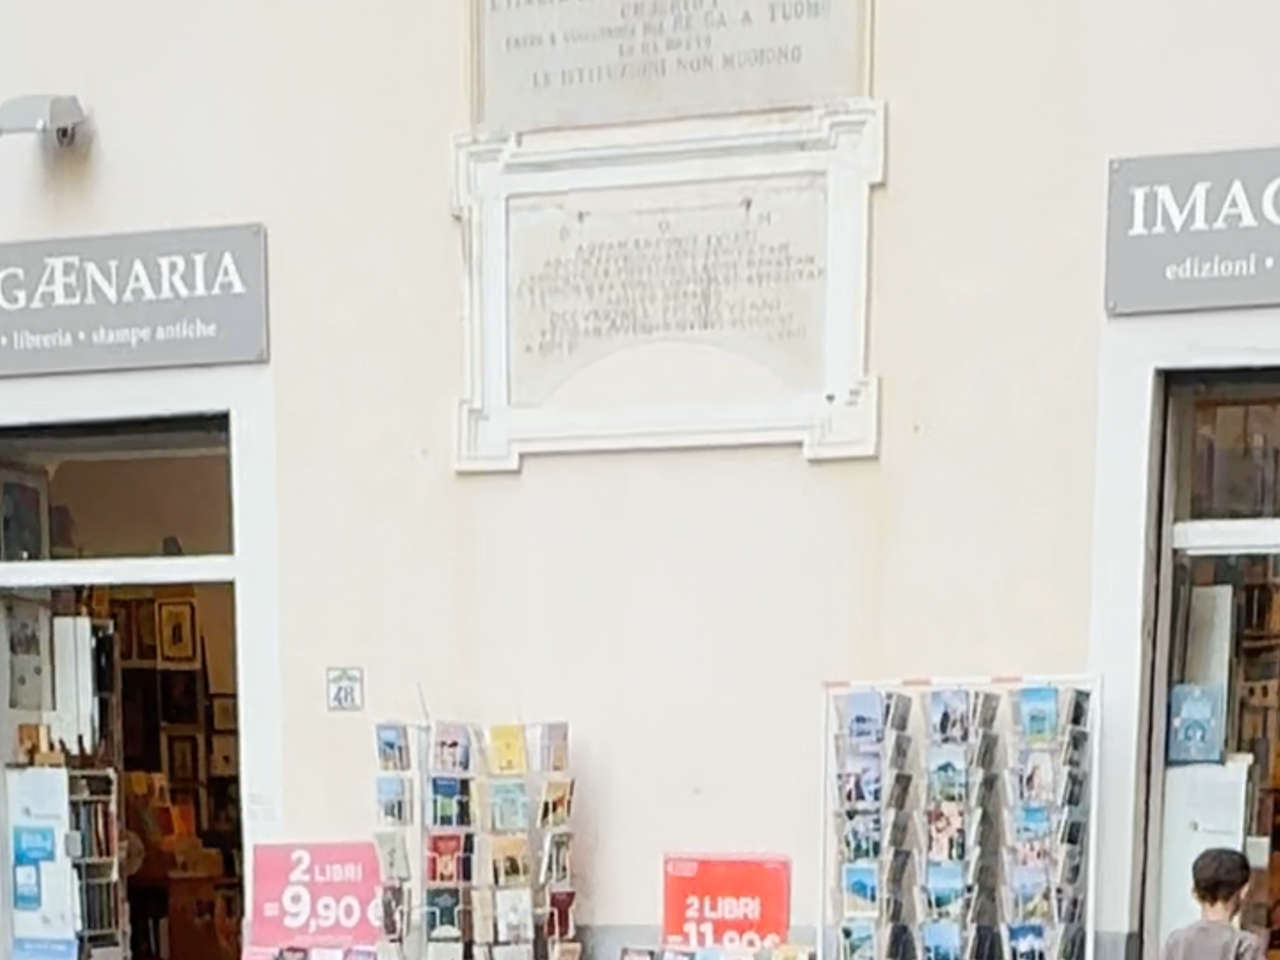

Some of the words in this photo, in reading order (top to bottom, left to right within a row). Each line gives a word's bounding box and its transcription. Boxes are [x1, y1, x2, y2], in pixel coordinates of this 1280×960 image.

[1164, 252, 1257, 281] edizioni
[12, 327, 74, 350] libreria
[91, 322, 152, 348] stampe
[155, 316, 218, 341] antiche
[289, 849, 311, 882] 2
[313, 862, 363, 883] LIBRI
[684, 894, 700, 919] 2
[703, 895, 762, 920] LIBRI
